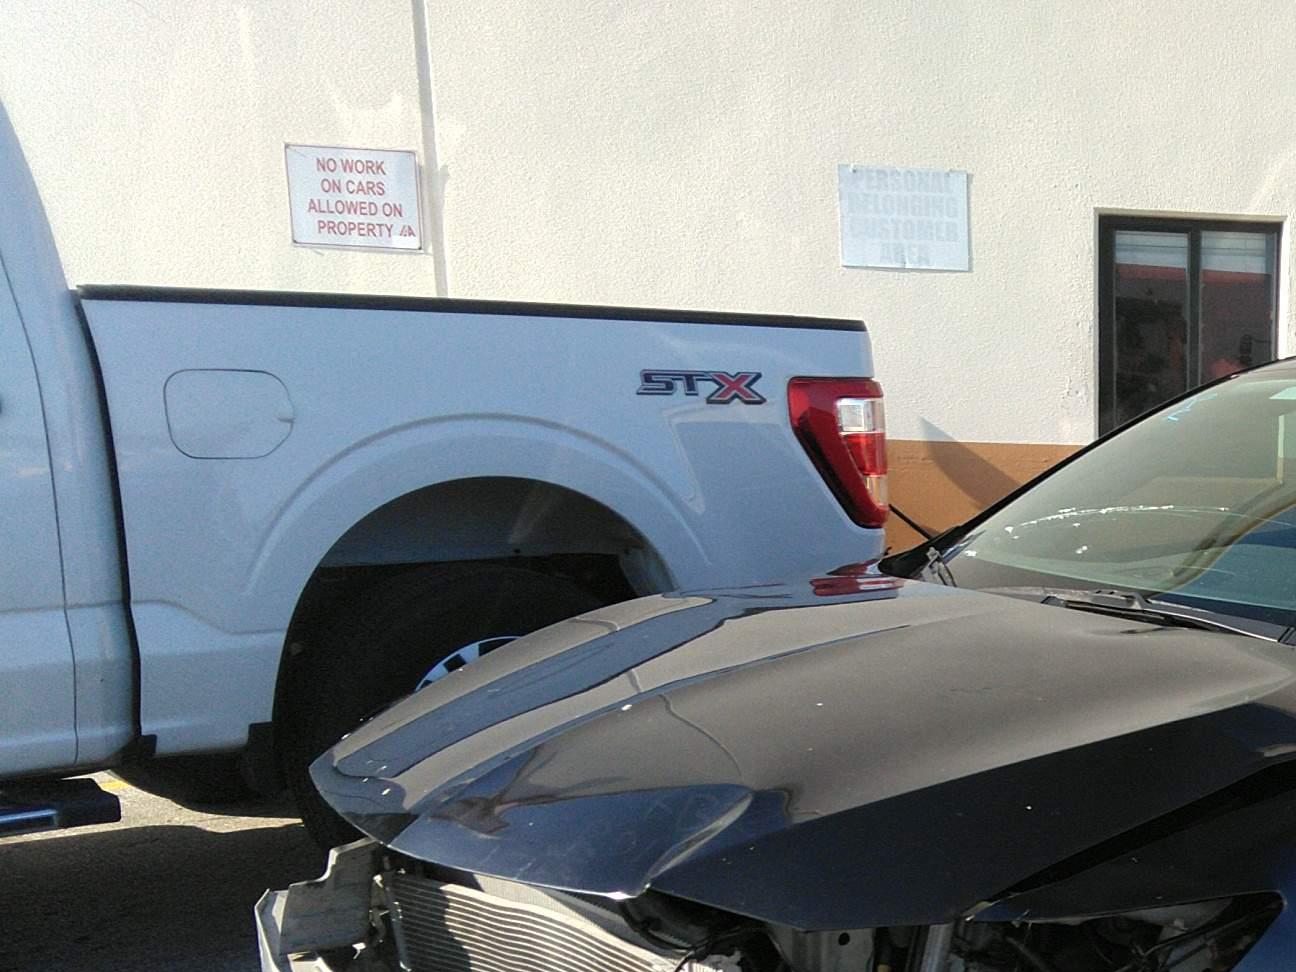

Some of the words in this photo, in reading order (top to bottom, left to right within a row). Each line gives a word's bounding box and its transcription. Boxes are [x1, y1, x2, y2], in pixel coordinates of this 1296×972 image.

[316, 158, 337, 173] NO
[340, 159, 386, 176] WORK
[321, 178, 342, 194] ON
[346, 181, 385, 196] CARS
[851, 169, 953, 194] PERSONAL
[308, 198, 378, 216] ALLOWED
[382, 202, 403, 217] ON
[317, 220, 393, 238] PROPERTY
[849, 216, 959, 242] CUSTOMER
[636, 369, 767, 405] STX
